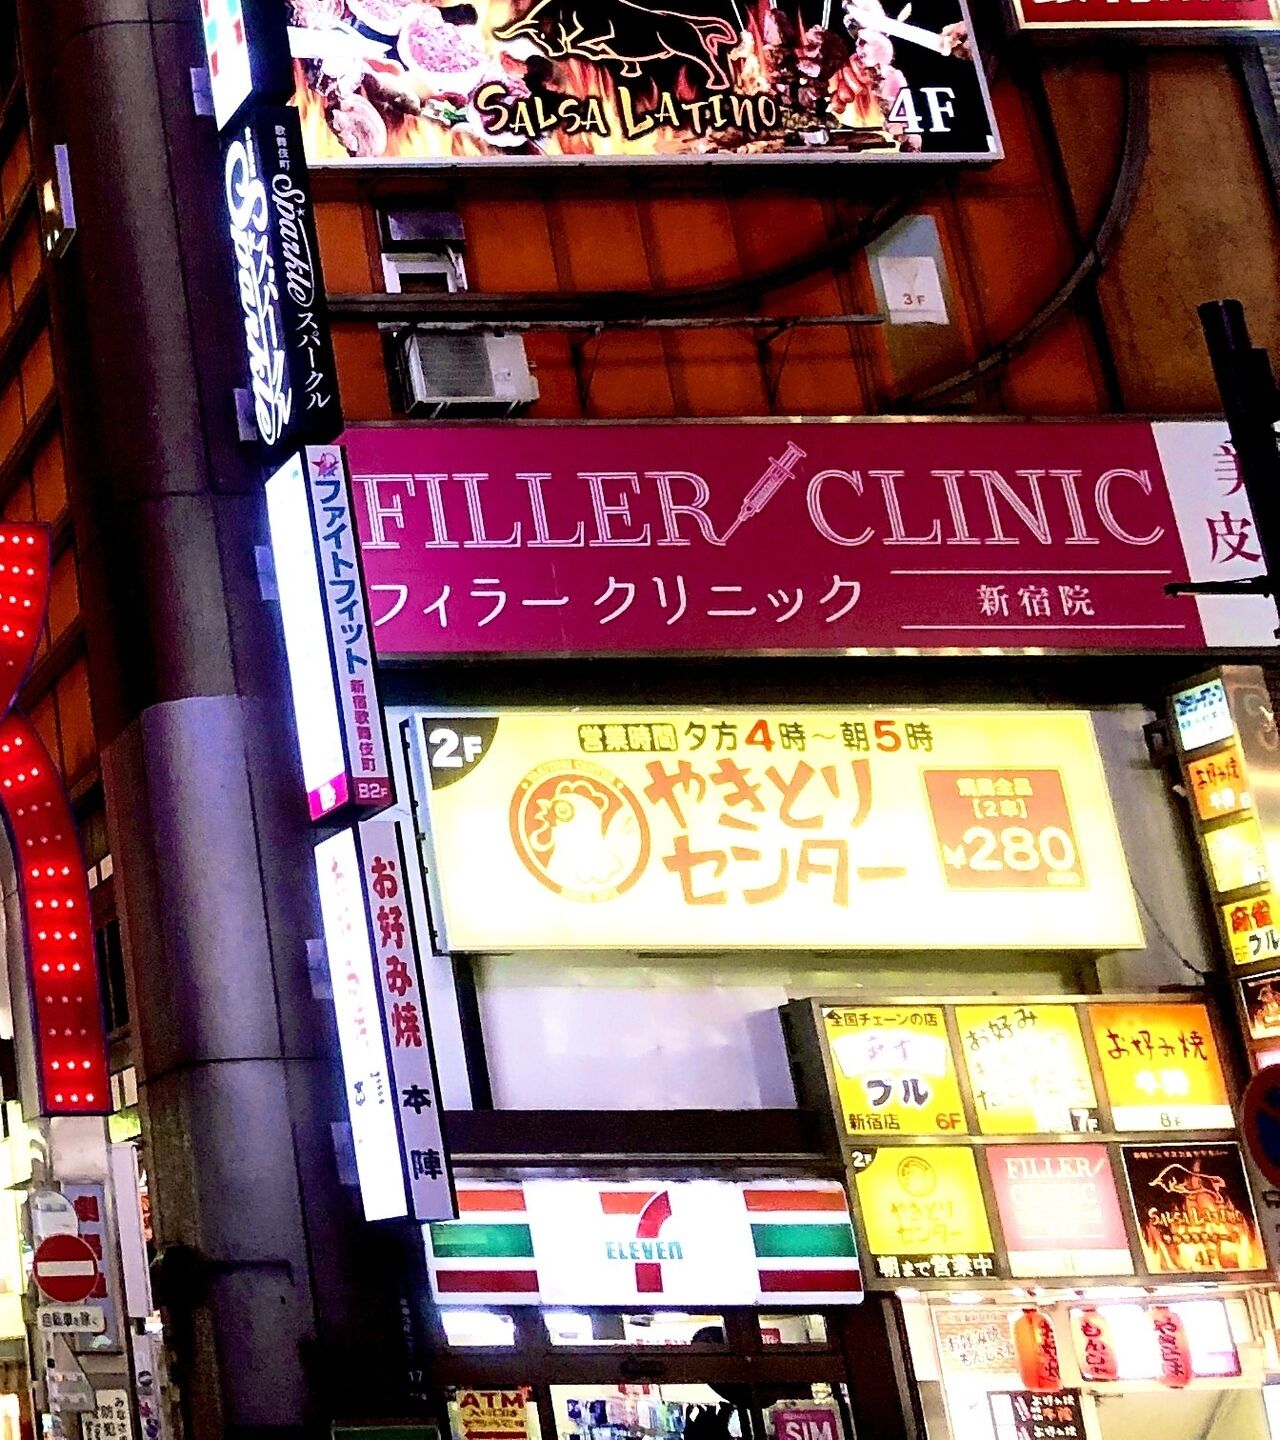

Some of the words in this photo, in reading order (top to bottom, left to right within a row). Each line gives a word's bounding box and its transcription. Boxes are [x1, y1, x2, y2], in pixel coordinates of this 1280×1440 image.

[887, 87, 957, 134] 4F
[270, 172, 313, 308] Sparkle
[903, 293, 926, 307] 3F
[296, 309, 331, 412] スパークル
[351, 469, 727, 552] FILLER
[805, 469, 1166, 548] CLINIC
[312, 479, 370, 675] ファイトフィット
[369, 575, 570, 629] フィラー
[593, 574, 865, 625] クリニック
[975, 583, 1096, 618] 新宿院
[349, 678, 377, 773] 新宿歌舞伎町
[428, 728, 483, 768] 2F
[647, 758, 872, 832] やきとり
[663, 835, 907, 906] センター
[370, 855, 423, 1048] お好み焼
[401, 1084, 444, 1180] 本陣
[831, 1013, 938, 1027] 全国チェーンの店
[1106, 1029, 1208, 1061] お好み焼
[848, 1113, 901, 1131] 新宿店
[936, 1113, 962, 1130] 6F
[1160, 1113, 1182, 1128] 8F
[851, 1151, 872, 1168] 2F
[1005, 1157, 1092, 1179] FILLER
[877, 1255, 993, 1278] 朝まで営業中
[460, 1391, 523, 1409] ATM
